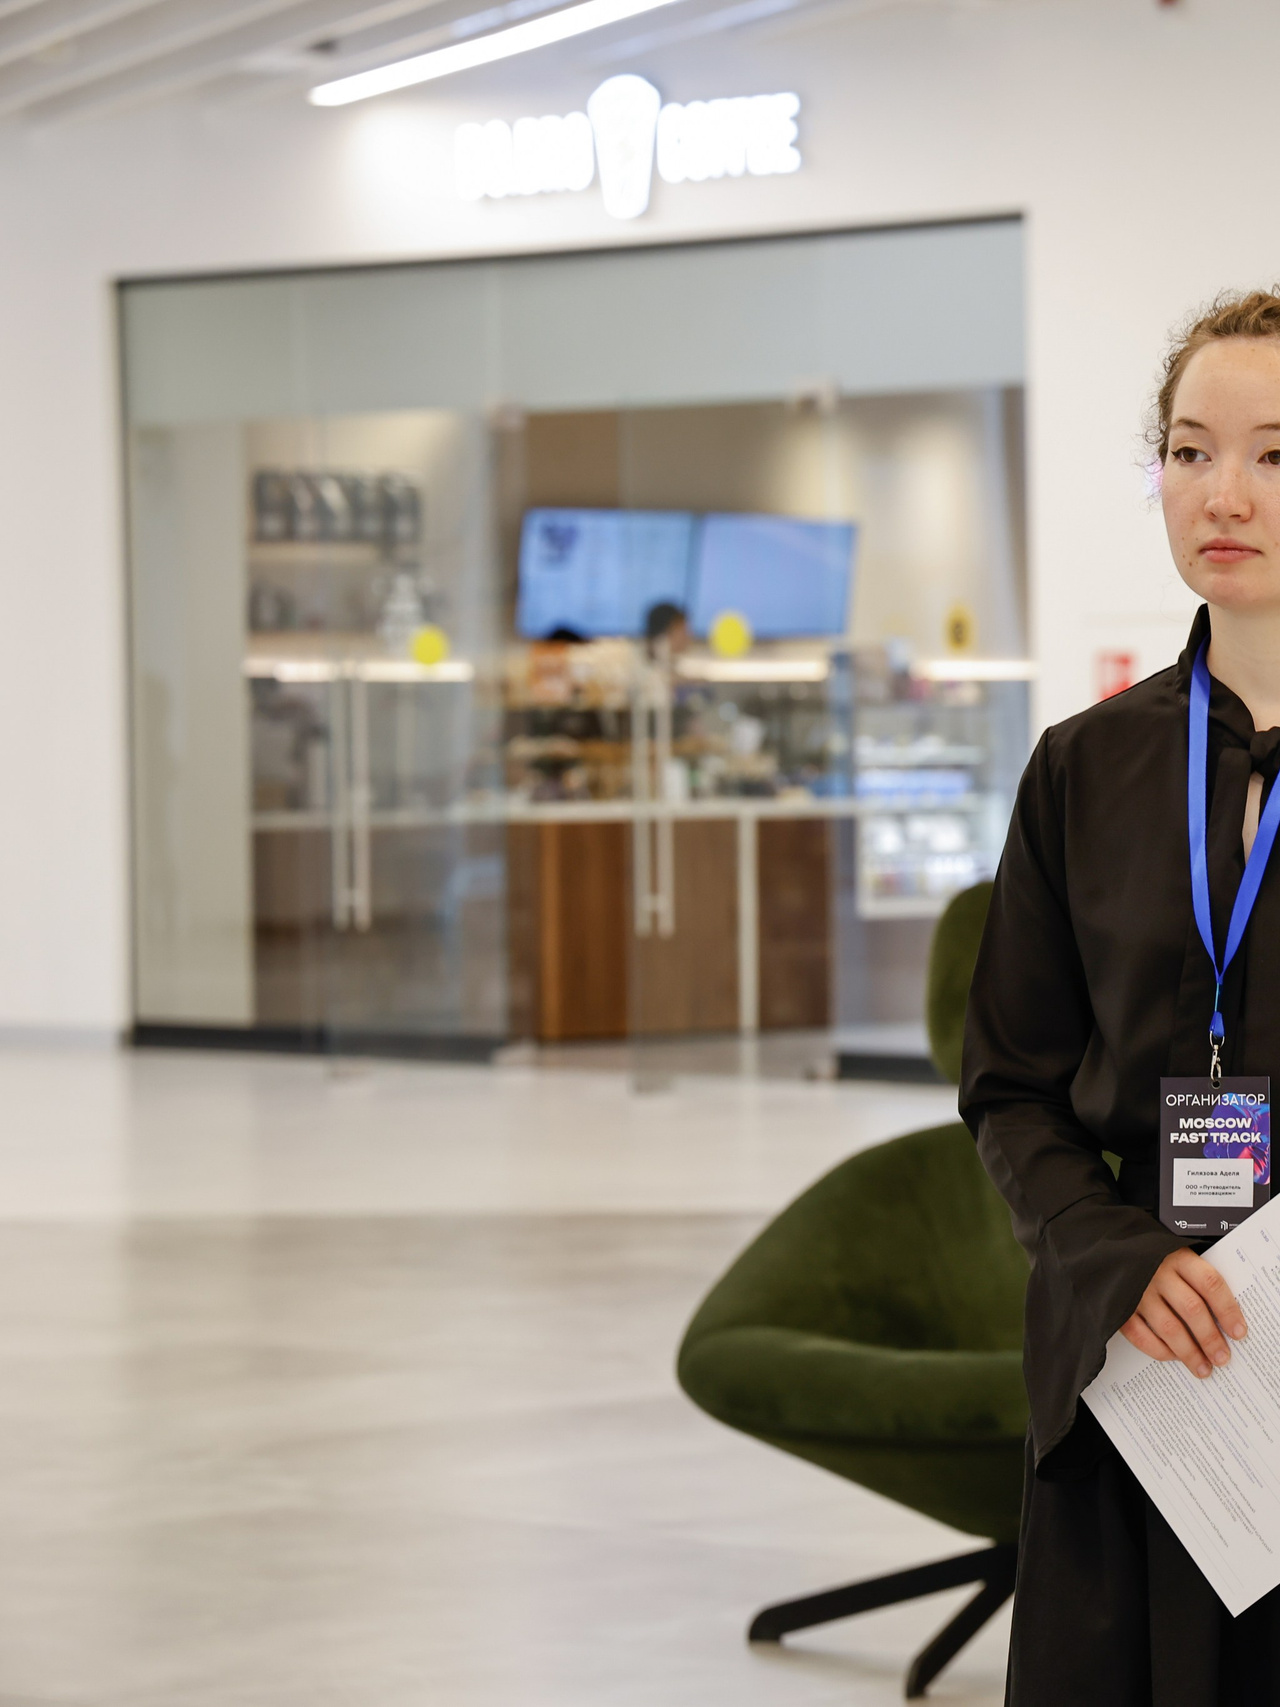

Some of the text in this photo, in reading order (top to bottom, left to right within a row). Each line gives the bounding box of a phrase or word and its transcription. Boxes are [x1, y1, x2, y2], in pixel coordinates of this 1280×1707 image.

[1165, 1093, 1266, 1107] ОРГАНИЗАТОР
[1179, 1117, 1252, 1129] MOSCOW
[1169, 1132, 1262, 1144] FAST TRACK
